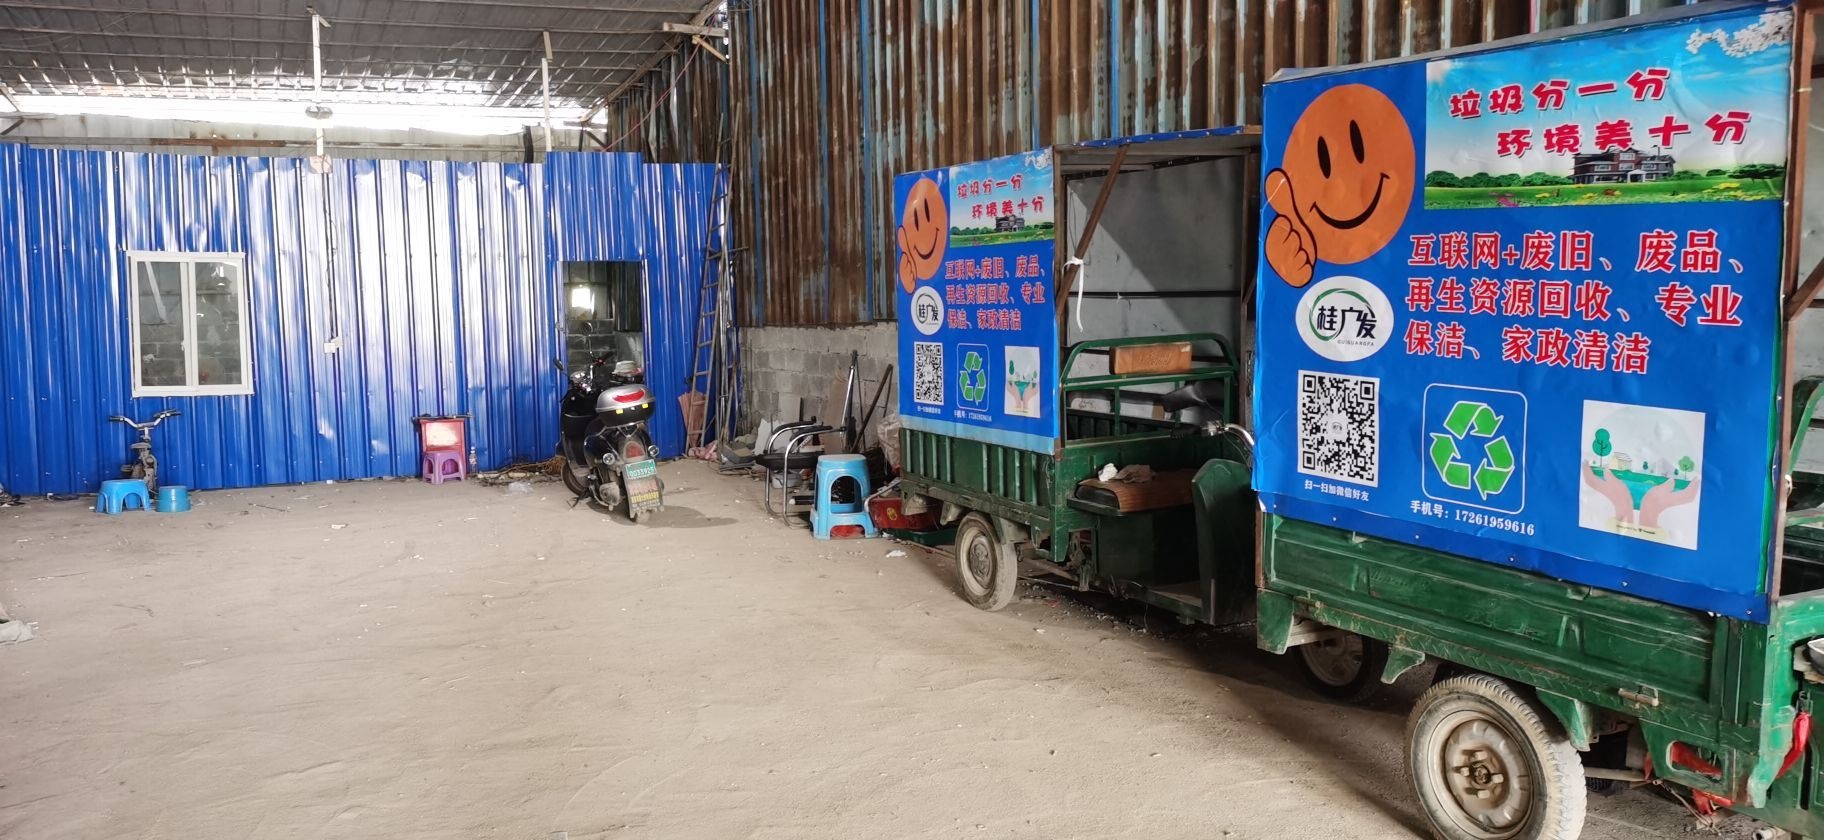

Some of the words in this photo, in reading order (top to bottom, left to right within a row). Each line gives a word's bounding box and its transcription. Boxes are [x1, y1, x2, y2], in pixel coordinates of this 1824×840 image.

[1448, 67, 1671, 119] 垃圾分一分
[1496, 110, 1752, 159] 环境美十分
[957, 174, 1022, 199] 垃圾分一分
[972, 196, 1044, 219] 环境美十分
[1407, 229, 1745, 274] 互联网+废旧、废品、
[1317, 305, 1377, 340] 桂广发
[1405, 276, 1745, 329] 再生资源回收、专业
[1403, 319, 1652, 375] 保洁、家政清洁
[1304, 479, 1370, 502] 扫一扫加微信好友
